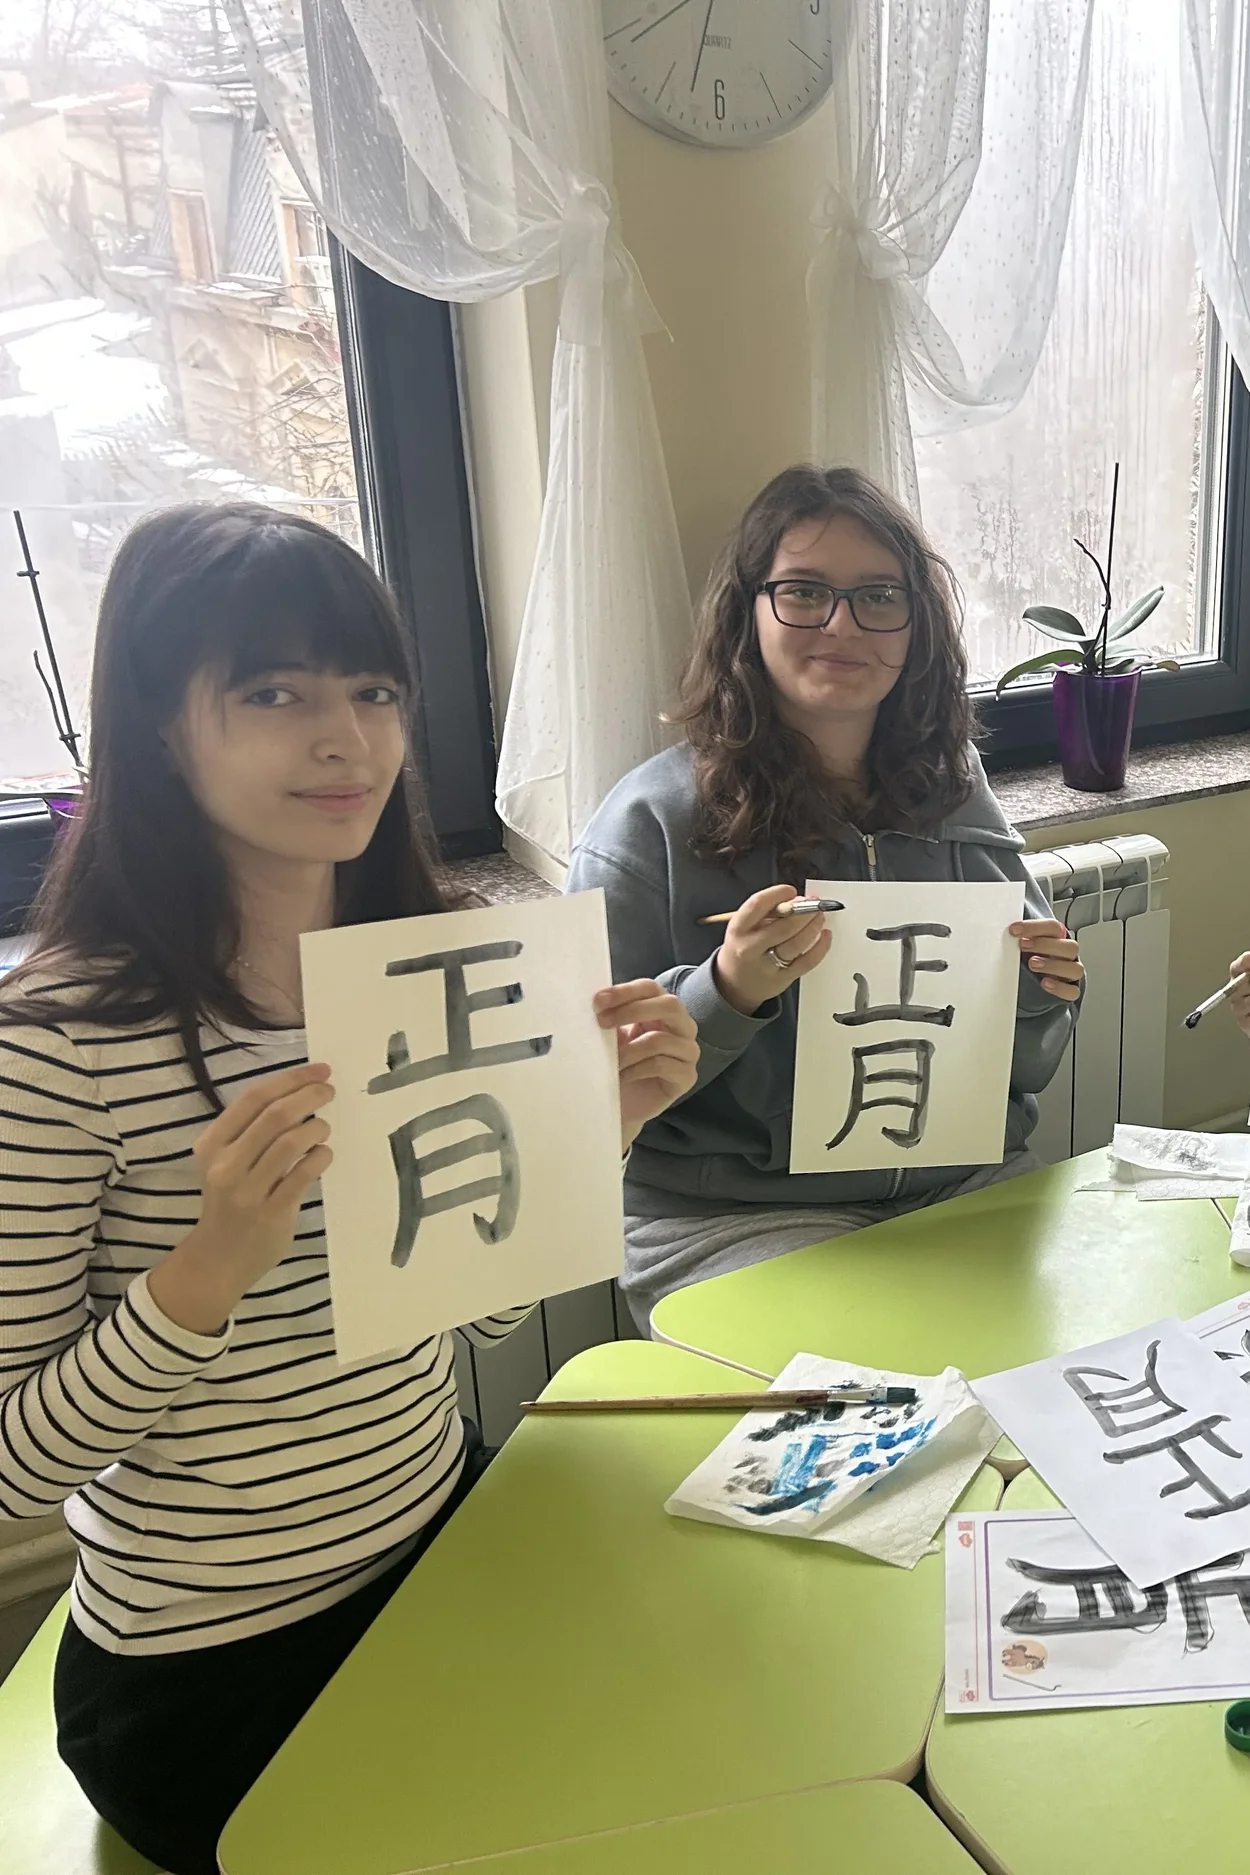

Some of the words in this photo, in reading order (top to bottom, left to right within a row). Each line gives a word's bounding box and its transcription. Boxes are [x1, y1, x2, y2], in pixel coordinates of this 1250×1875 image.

[713, 79, 726, 121] 6
[361, 940, 554, 1269] 正月
[826, 922, 956, 1150] 正月
